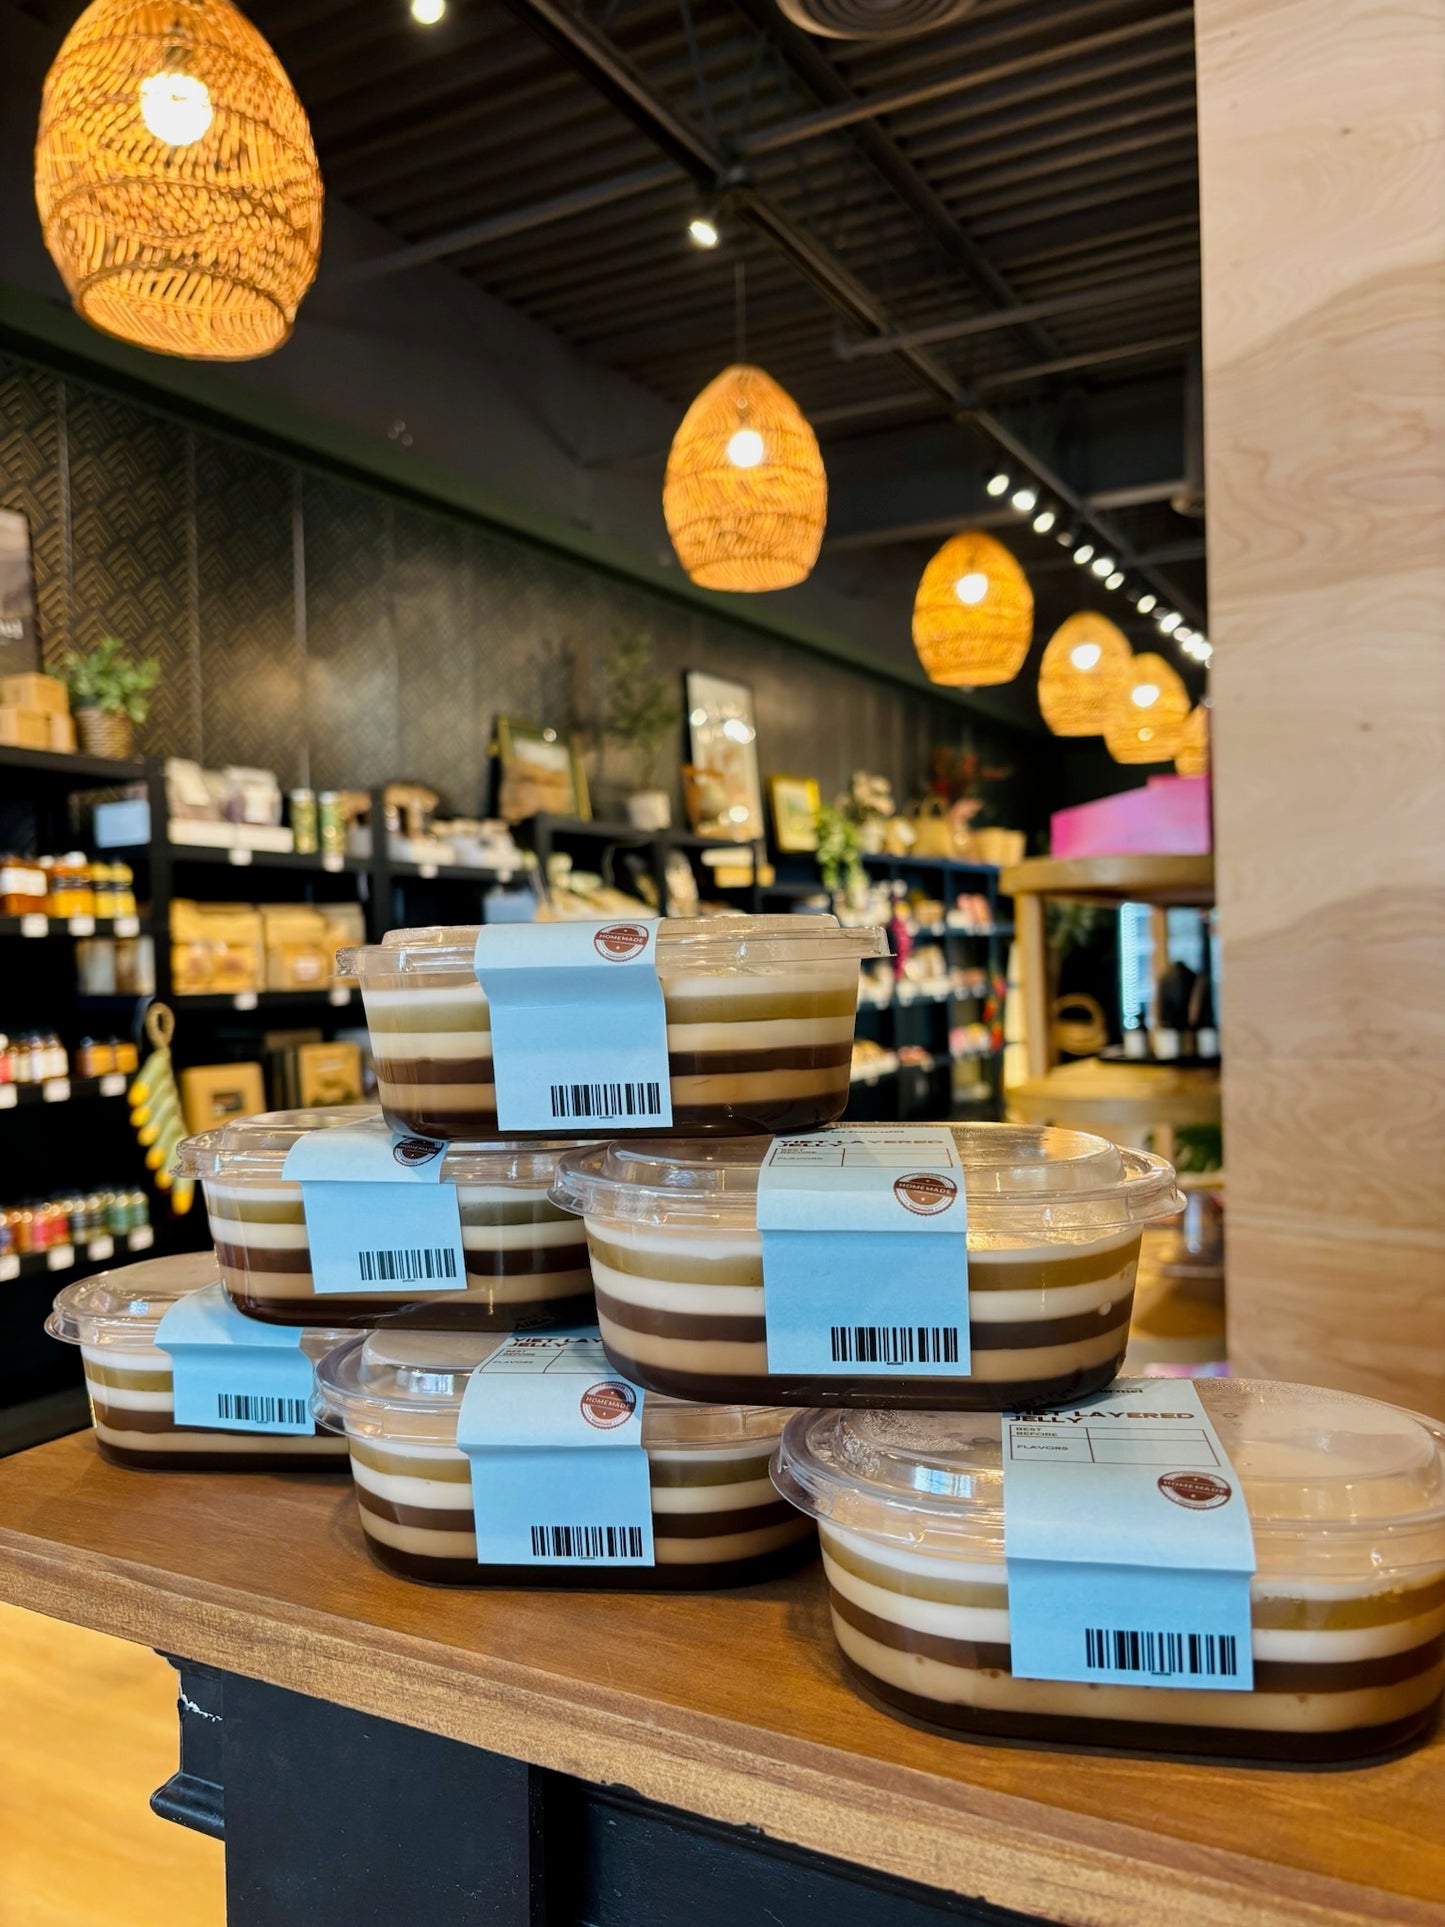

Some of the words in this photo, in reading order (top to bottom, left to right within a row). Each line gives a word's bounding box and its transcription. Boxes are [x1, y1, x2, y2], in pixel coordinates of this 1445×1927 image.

[598, 933, 644, 943] HOMEMADE
[898, 1182, 953, 1194] HOMEMADE
[585, 1396, 631, 1410] HOMEMADE
[1009, 1415, 1084, 1423] JELLY
[1074, 1410, 1195, 1419] LAYERED
[1162, 1480, 1225, 1494] HOMEMADE
